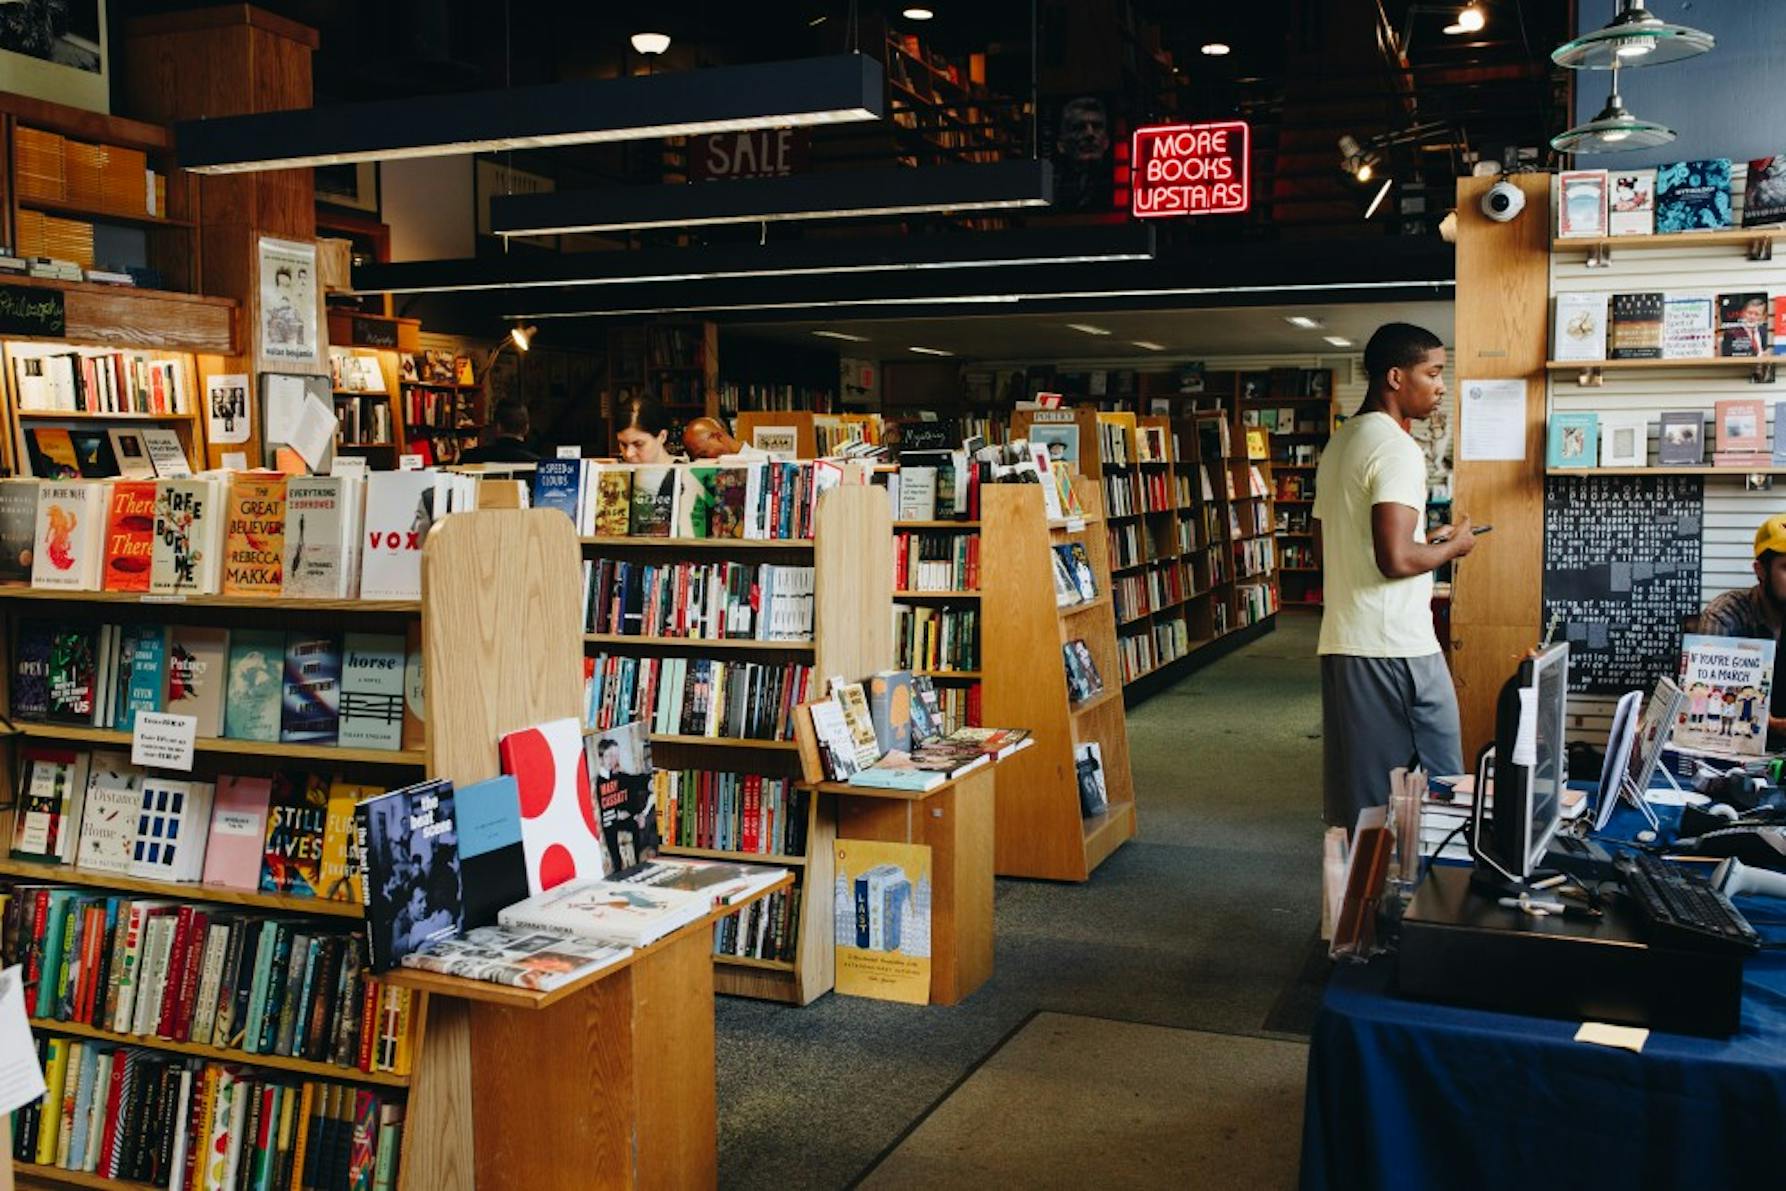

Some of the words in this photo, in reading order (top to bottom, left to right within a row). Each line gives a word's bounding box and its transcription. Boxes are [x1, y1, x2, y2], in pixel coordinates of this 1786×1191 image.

[707, 130, 793, 174] SALE
[1153, 131, 1227, 158] MORE
[1148, 157, 1232, 180] BOOKS
[1137, 184, 1242, 210] UPSTAIRS
[546, 464, 567, 474] SPEED
[289, 488, 336, 498] EVERYTHING
[241, 502, 280, 516] GREAT
[370, 532, 420, 550] VOX
[232, 551, 281, 564] REBECCA
[348, 652, 397, 670] horse
[1700, 652, 1730, 666] YOU'RE
[1732, 657, 1760, 668] GOING
[1698, 669, 1708, 680] TO
[1710, 671, 1716, 680] A
[1718, 670, 1750, 682] MARCH
[74, 700, 90, 714] US
[94, 788, 139, 806] Distance
[420, 796, 438, 812] the
[273, 806, 322, 832] STILL
[84, 823, 116, 840] Home
[266, 834, 322, 860] LIVES
[858, 892, 867, 934] LAST
